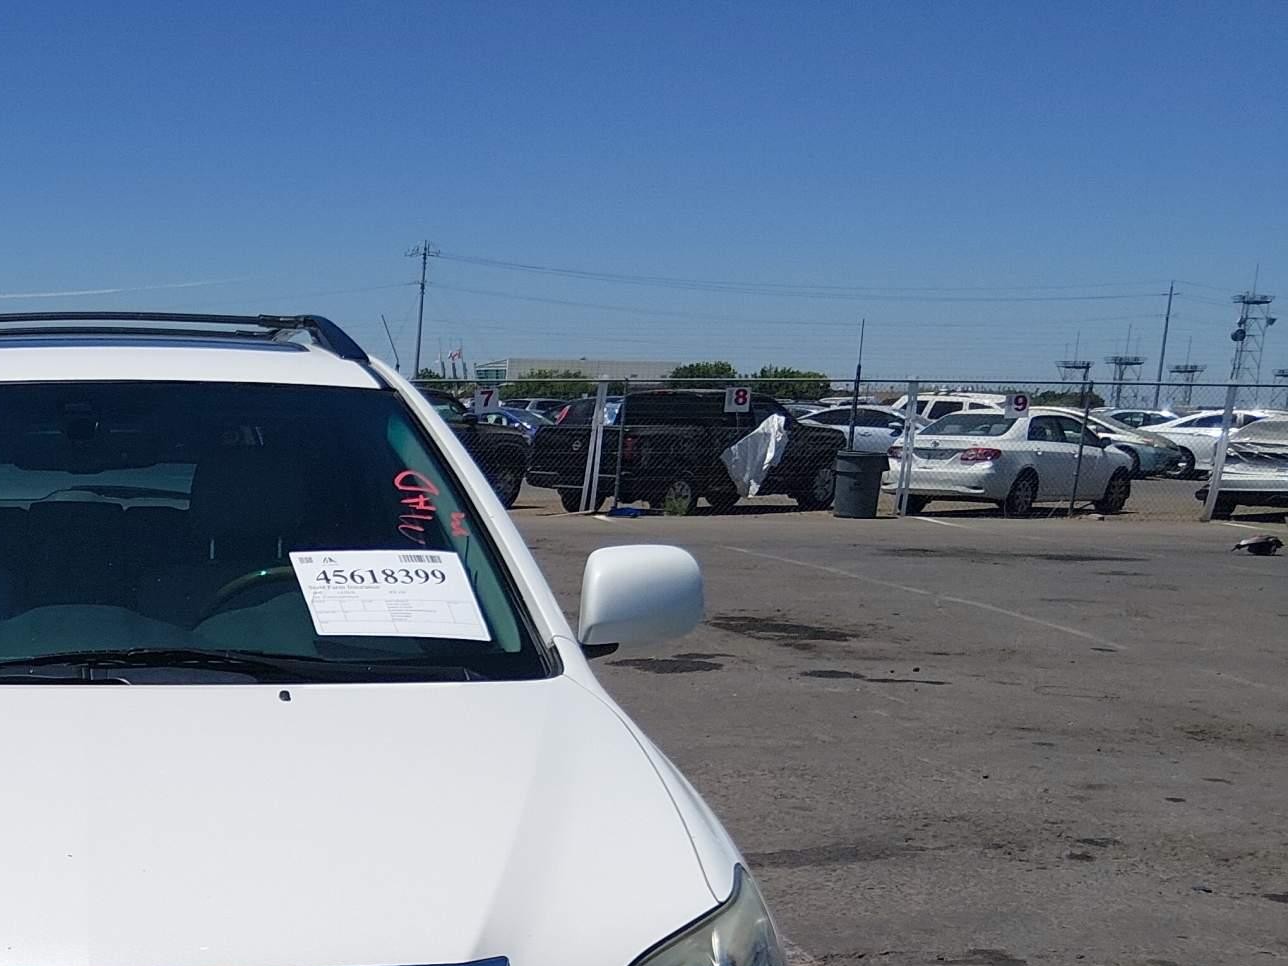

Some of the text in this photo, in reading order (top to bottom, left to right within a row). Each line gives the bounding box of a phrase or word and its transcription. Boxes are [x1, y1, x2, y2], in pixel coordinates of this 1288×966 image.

[480, 390, 493, 407] 7
[734, 388, 748, 406] 8
[1014, 395, 1028, 412] 9
[316, 568, 446, 585] 45618399
